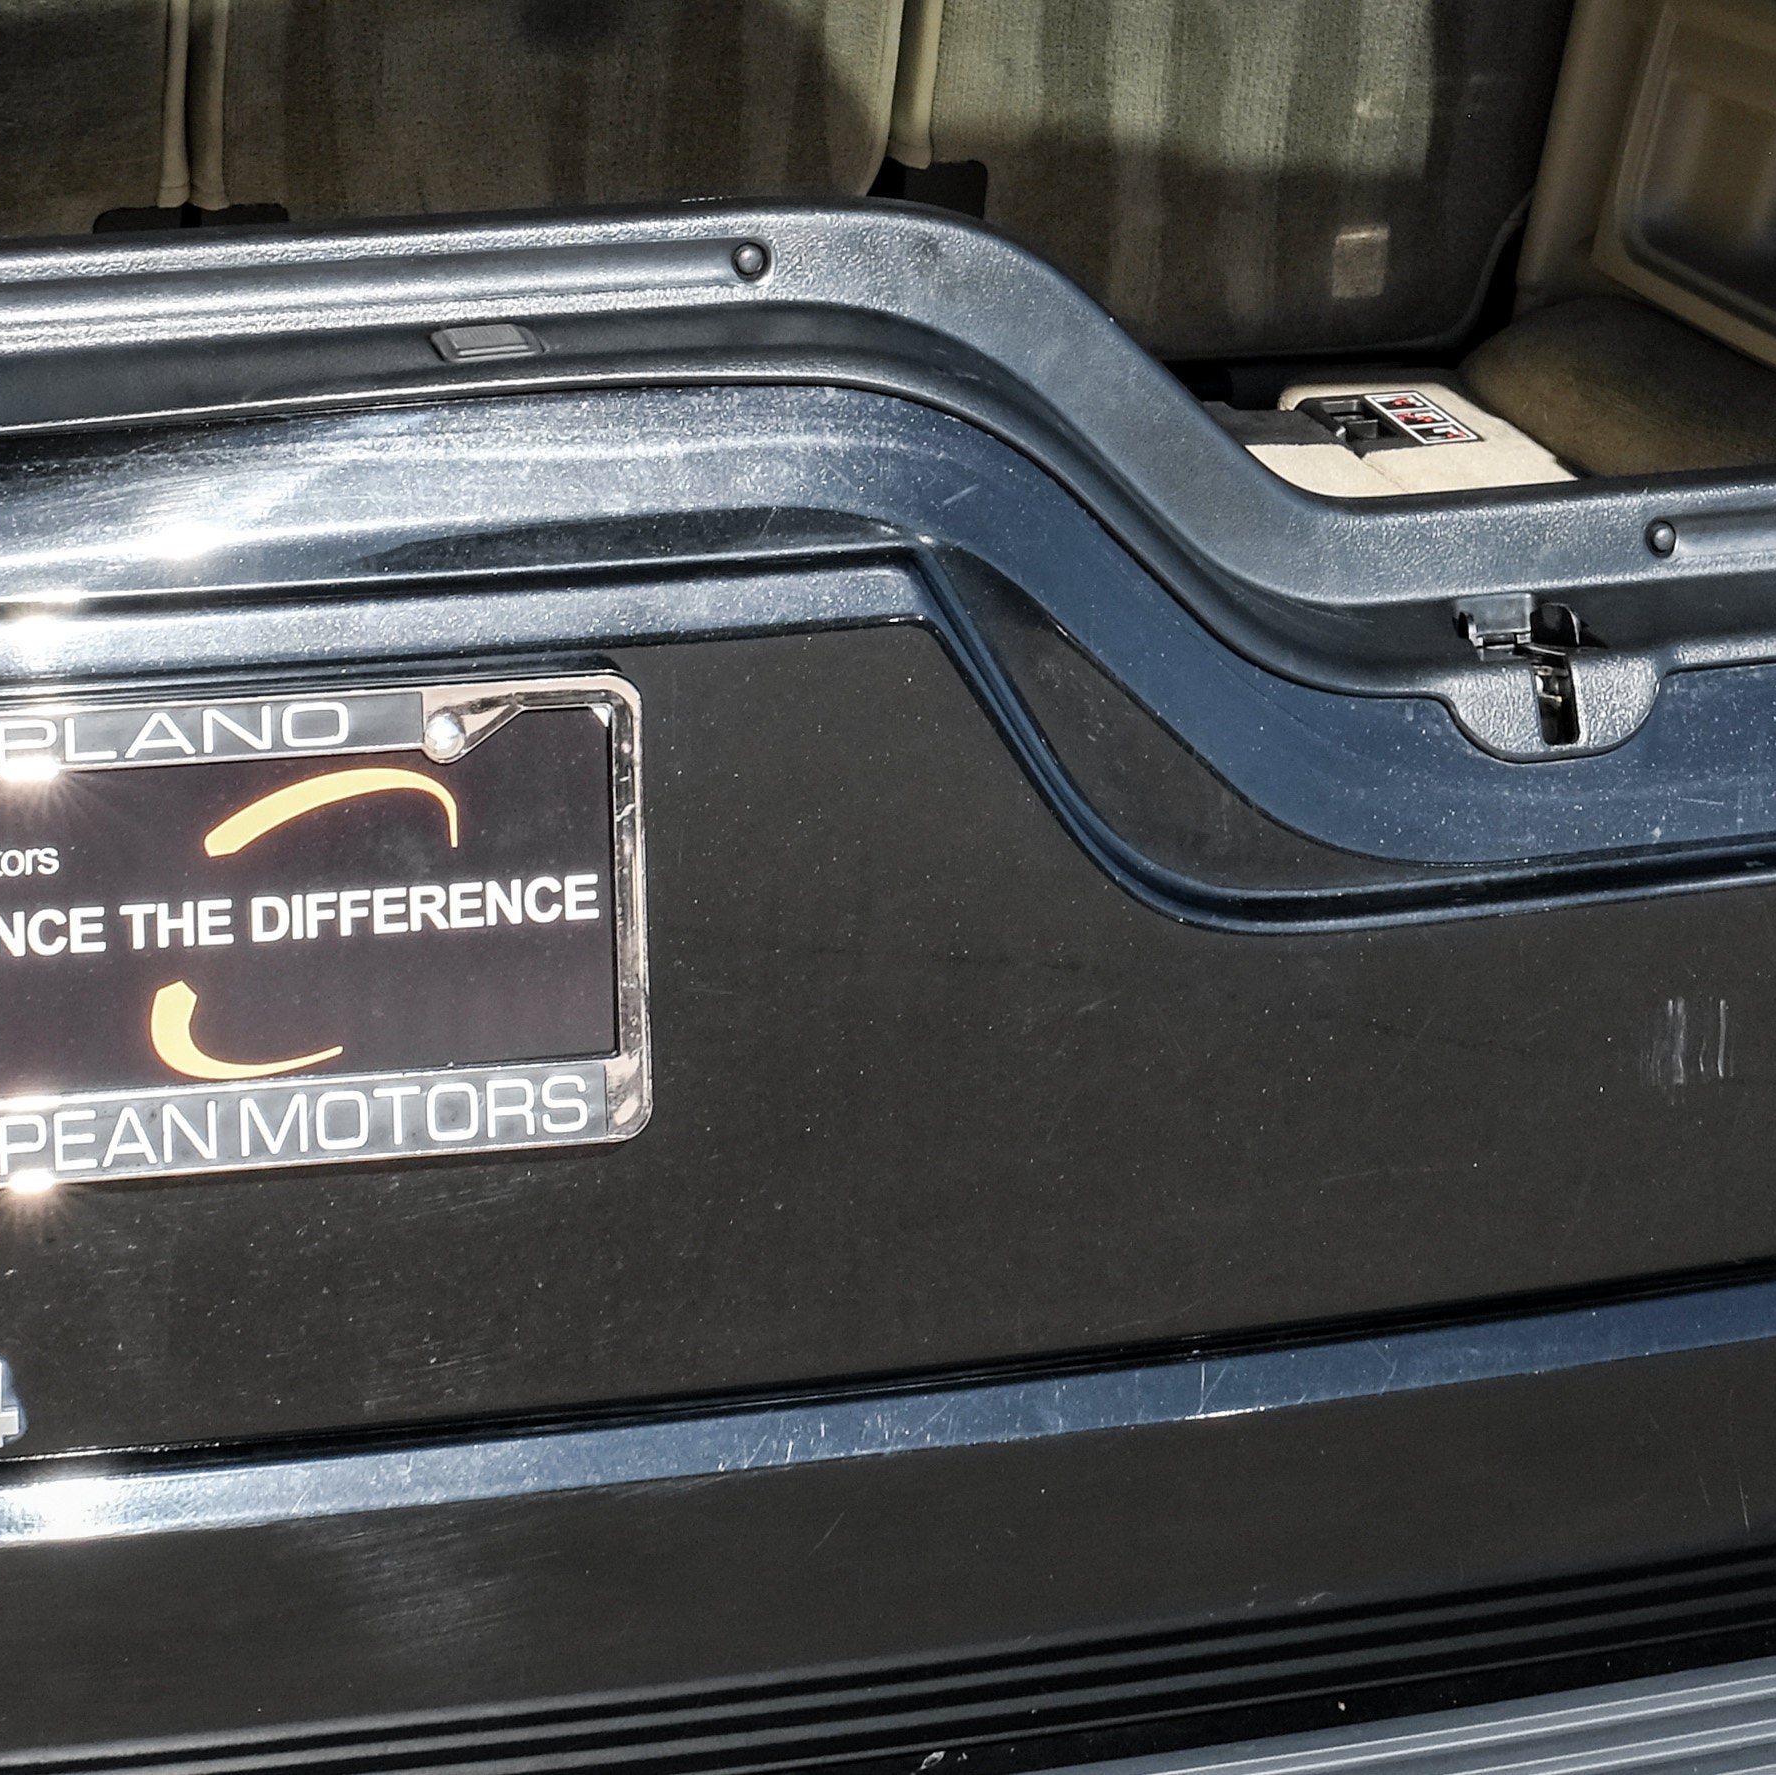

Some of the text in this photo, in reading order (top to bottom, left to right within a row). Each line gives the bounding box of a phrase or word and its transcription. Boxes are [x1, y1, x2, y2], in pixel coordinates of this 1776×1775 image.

[119, 897, 234, 951] THE
[249, 874, 601, 944] DIFFERENCE
[238, 1076, 590, 1155] MOTORS
